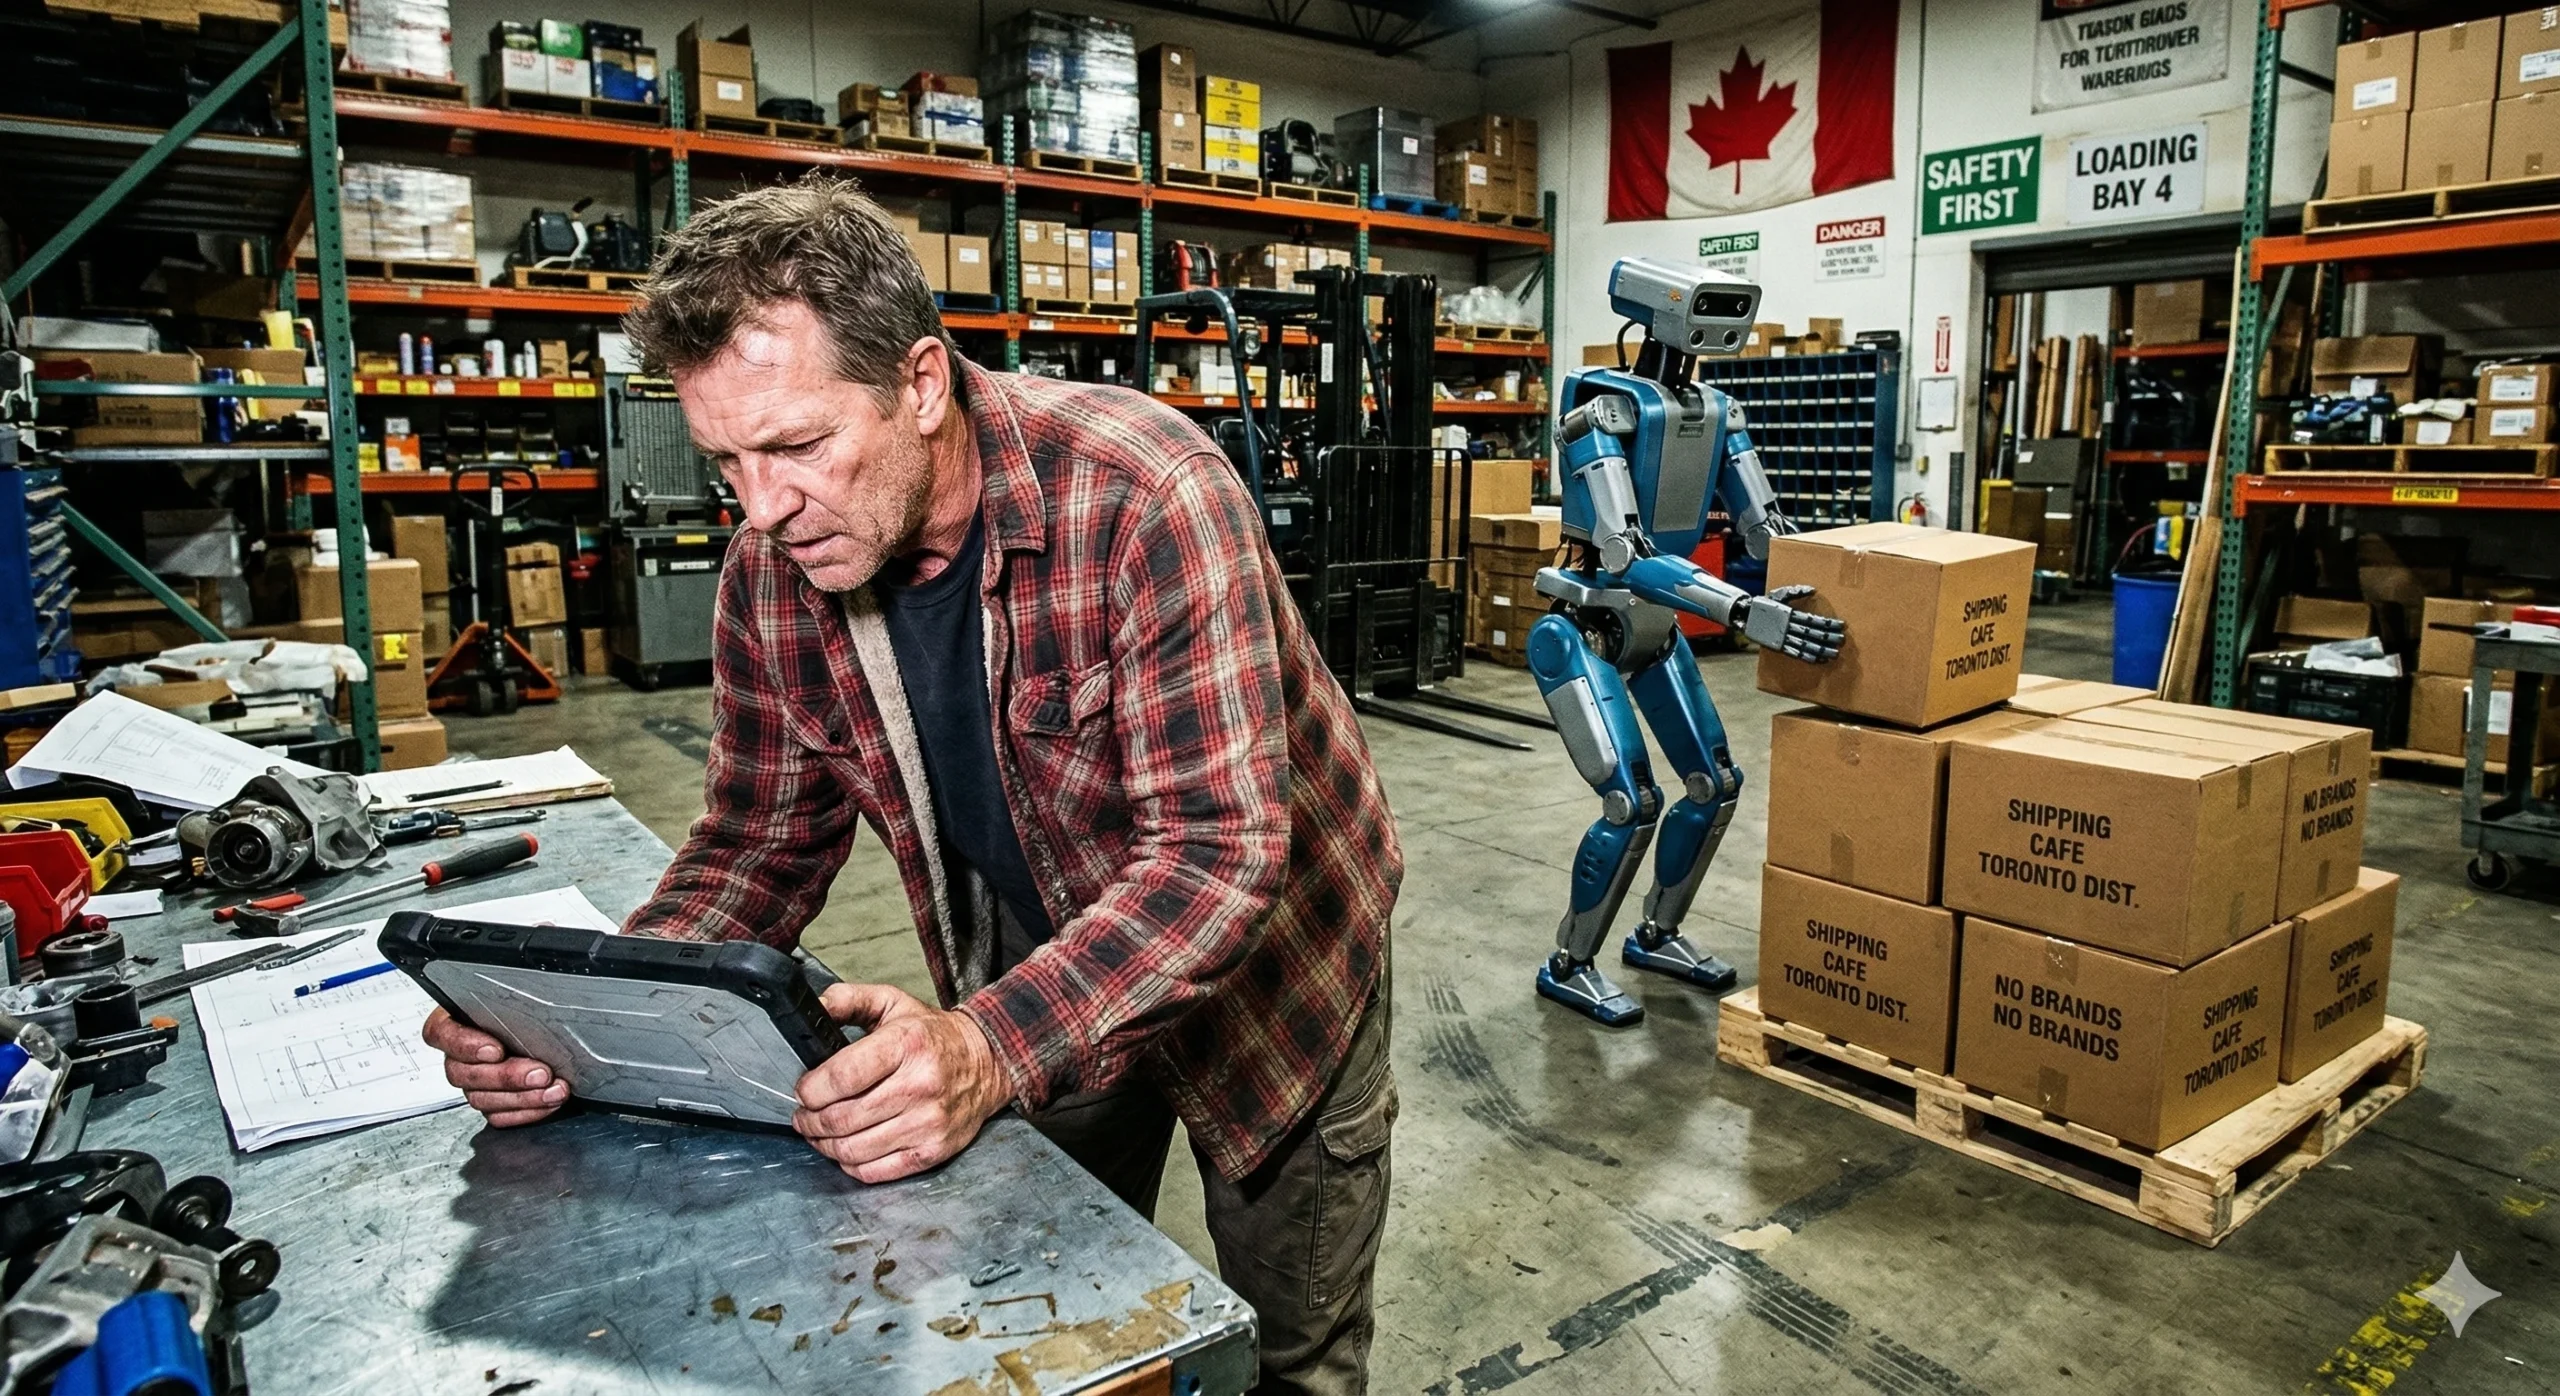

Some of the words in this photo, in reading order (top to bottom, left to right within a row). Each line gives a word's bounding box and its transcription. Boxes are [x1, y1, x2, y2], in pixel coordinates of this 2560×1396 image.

[2060, 49, 2090, 69] FOR
[1927, 145, 2035, 190] SAFETY
[2076, 133, 2198, 177] LOADING
[1939, 187, 2019, 226] FIRST
[2092, 178, 2147, 211] BAY
[2155, 174, 2173, 203] 4
[1701, 238, 1732, 255] SAFETY
[1733, 234, 1758, 250] FIRST
[1819, 220, 1882, 241] DANGER
[1963, 593, 2008, 623] SHIPPING
[1970, 622, 1996, 648] CAFE
[1945, 649, 1989, 680] TORONTO
[1989, 643, 2011, 667] DIST.
[2303, 789, 2318, 814] NO
[2319, 777, 2357, 809] BRANDS
[2008, 798, 2111, 840] SHIPPING
[2300, 818, 2316, 844] NO
[2316, 804, 2354, 838] BRANDS
[2029, 832, 2085, 865] CAFE
[1978, 851, 2077, 893] TORONTO
[2083, 874, 2140, 908] DIST.
[1806, 919, 1888, 961] SHIPPING
[1823, 950, 1867, 982] CAFE
[1783, 963, 1860, 1006] TORONTO
[1866, 990, 1909, 1023] DIST.
[1995, 973, 2024, 1001] NO
[2030, 984, 2122, 1031] BRANDS
[2203, 985, 2258, 1030] SHIPPING
[1993, 1002, 2022, 1031] NO
[2029, 1013, 2120, 1062] BRANDS
[2212, 1020, 2243, 1054] CAFE
[2184, 1050, 2239, 1097] TORONTO
[2240, 1036, 2268, 1068] DIST.
